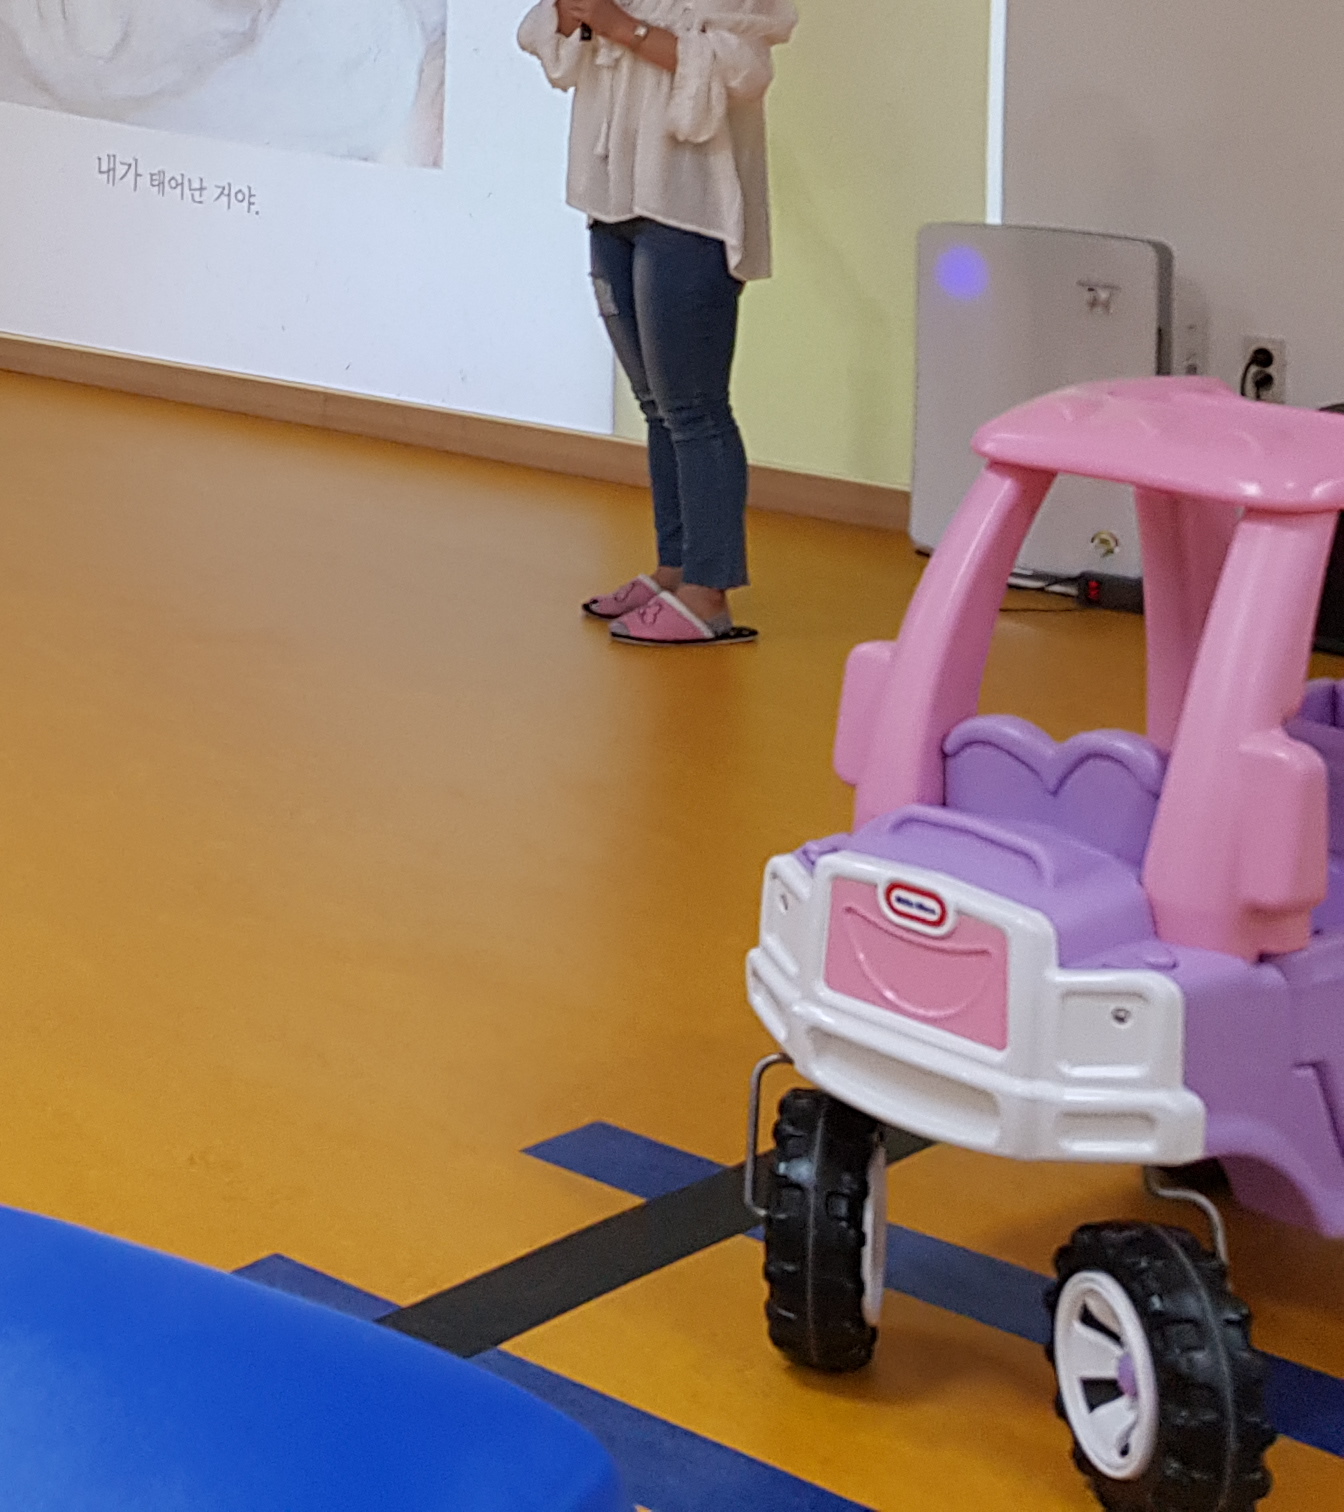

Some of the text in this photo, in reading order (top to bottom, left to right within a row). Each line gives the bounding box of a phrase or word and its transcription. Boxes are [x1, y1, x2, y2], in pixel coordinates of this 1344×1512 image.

[97, 153, 260, 215] 내가 태어난 거야.
